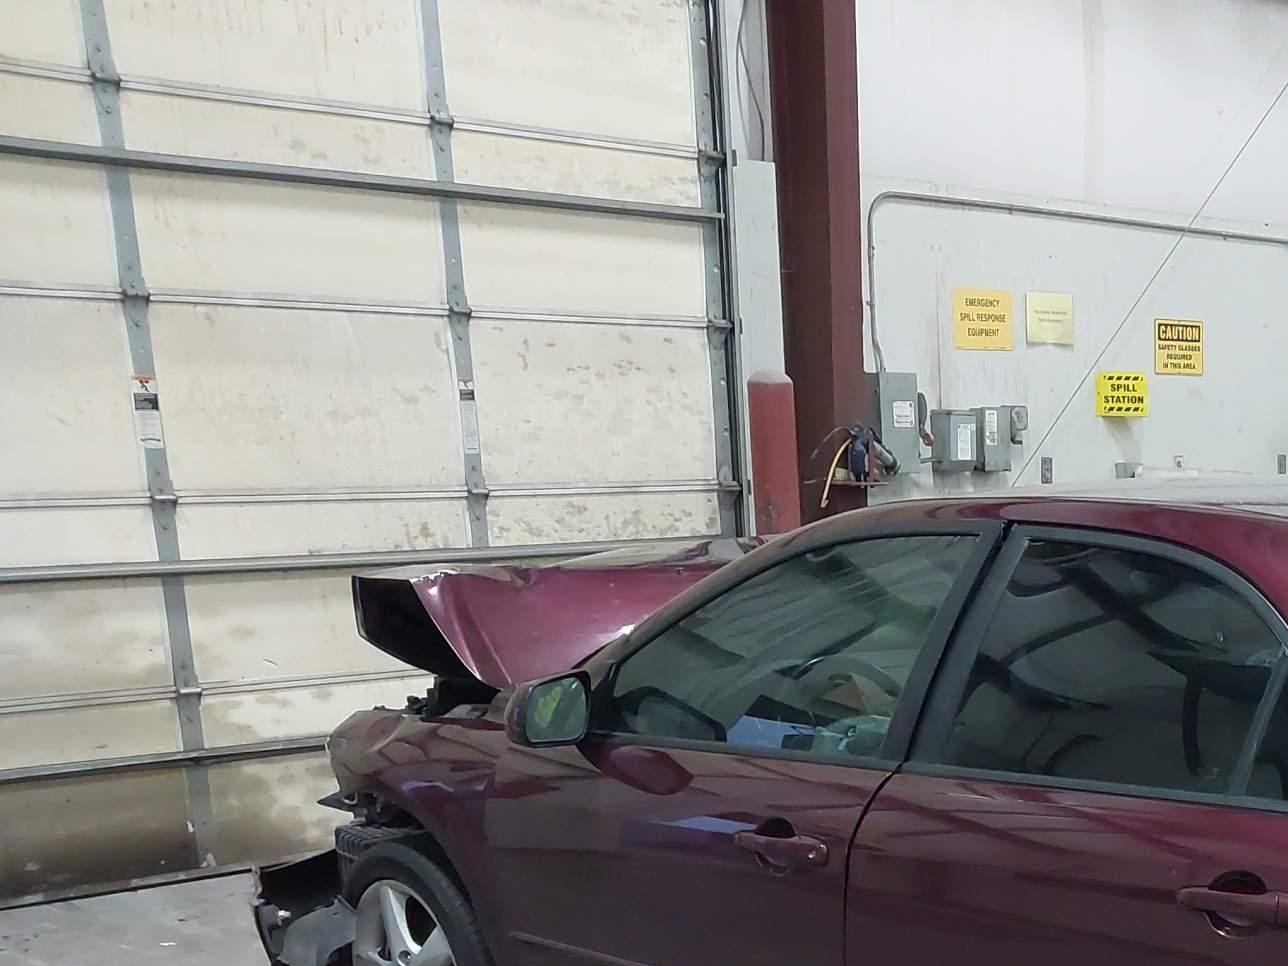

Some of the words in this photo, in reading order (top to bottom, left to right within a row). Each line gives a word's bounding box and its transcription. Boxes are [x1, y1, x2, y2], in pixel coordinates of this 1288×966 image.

[965, 298, 1000, 308] EMERGENCY
[960, 312, 976, 322] SPILL
[976, 313, 1006, 323] RESPONSE
[967, 328, 1000, 337] EQUIPMENT
[1159, 325, 1199, 341] CAUTION
[1178, 344, 1201, 352] GLASSES
[1166, 353, 1193, 361] REQUIRED
[1110, 383, 1138, 393] SPILL
[1103, 395, 1144, 404] STATION
